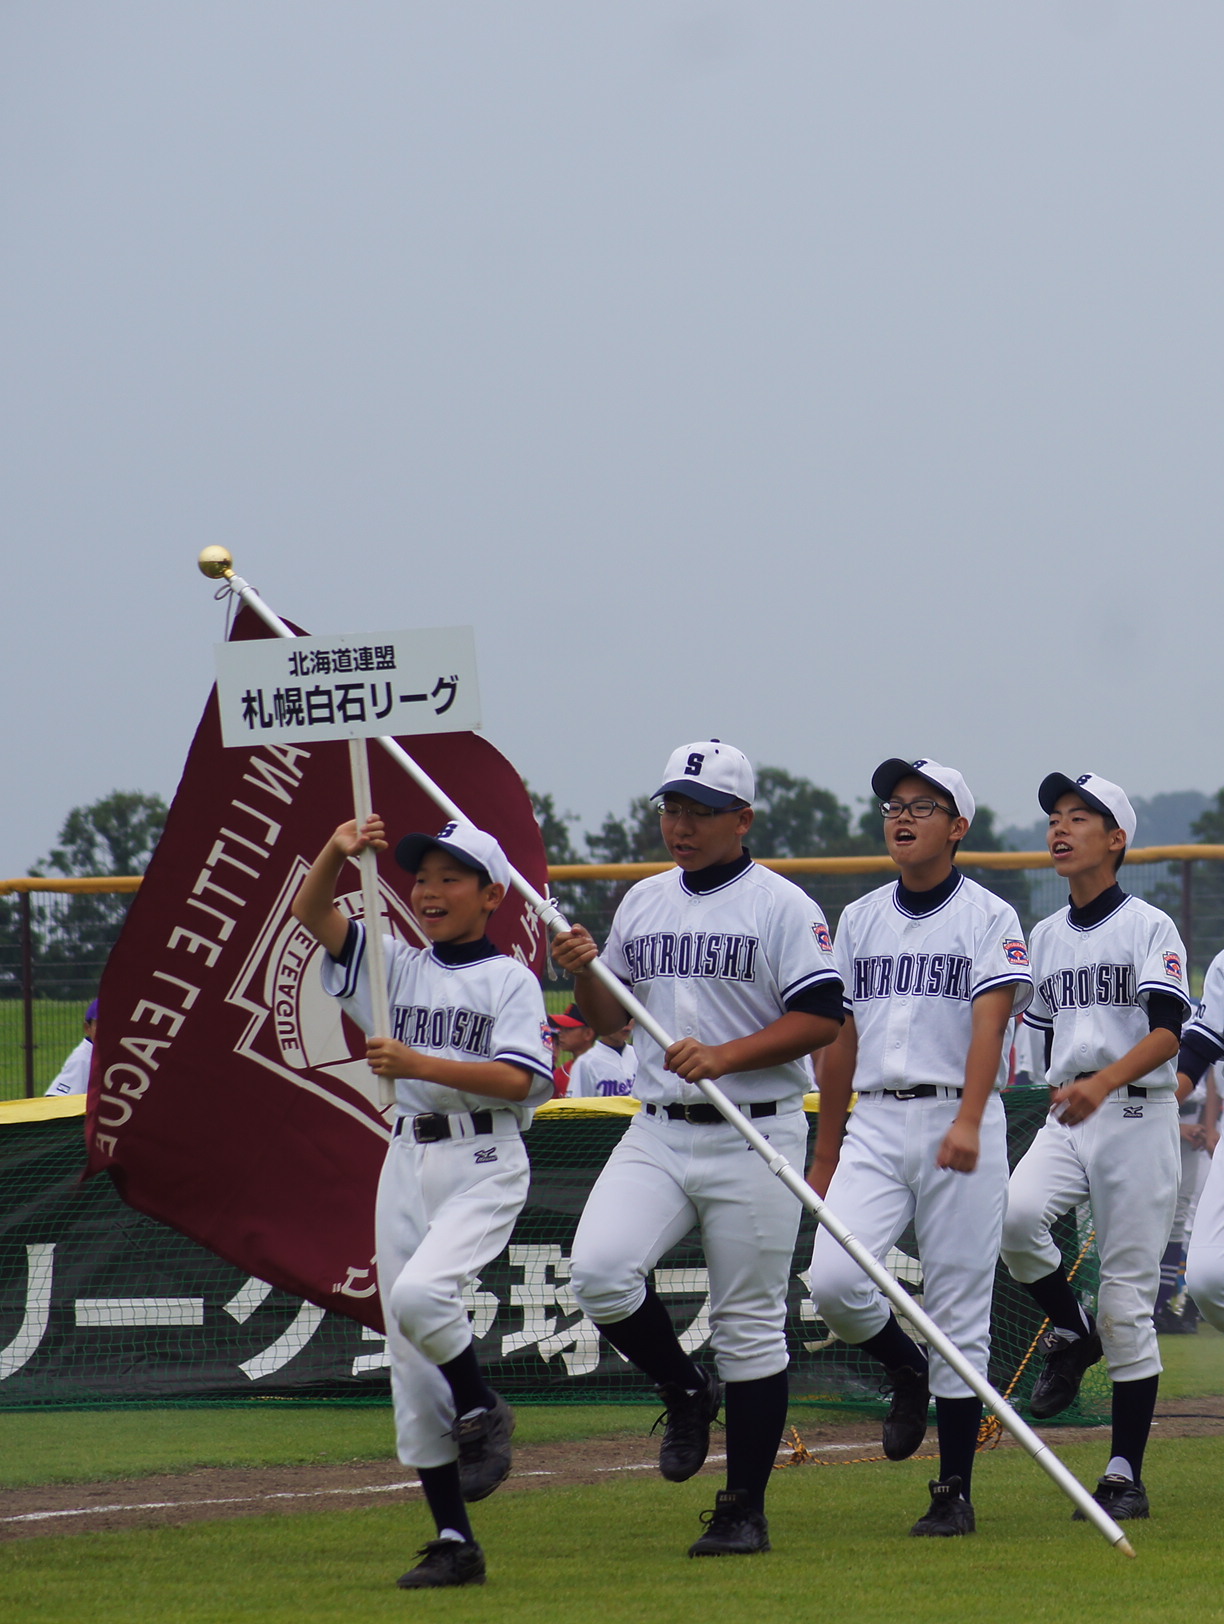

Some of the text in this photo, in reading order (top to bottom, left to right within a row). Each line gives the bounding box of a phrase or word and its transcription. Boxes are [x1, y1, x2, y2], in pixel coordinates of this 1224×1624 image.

[288, 645, 396, 677] 北海道連盟
[241, 675, 459, 730] 札幌白石リーグ
[684, 752, 705, 776] S
[853, 952, 973, 1002] HIROISHI
